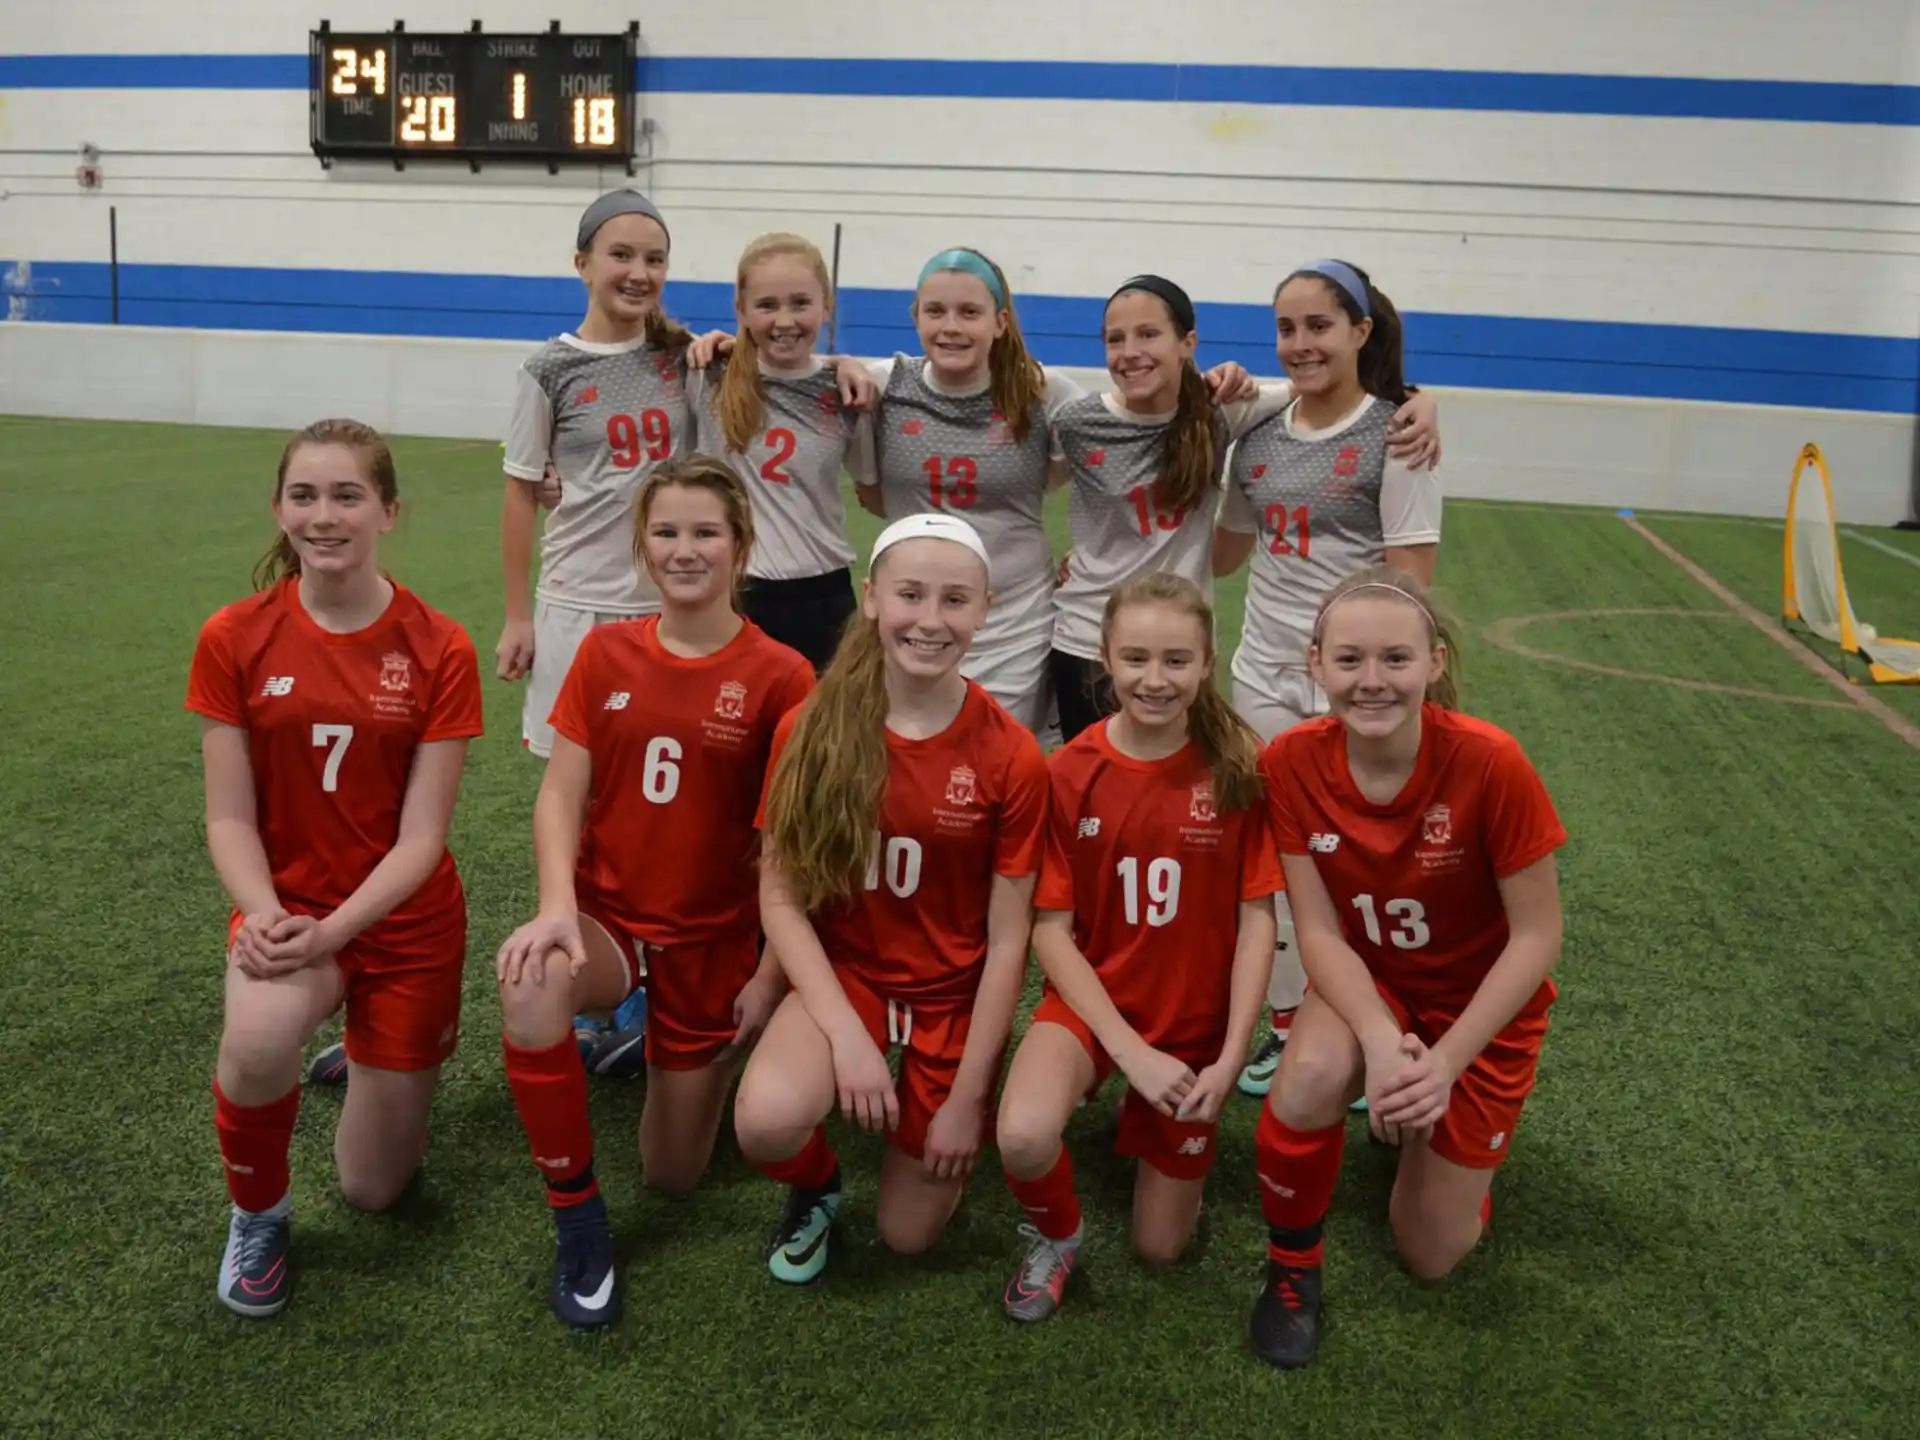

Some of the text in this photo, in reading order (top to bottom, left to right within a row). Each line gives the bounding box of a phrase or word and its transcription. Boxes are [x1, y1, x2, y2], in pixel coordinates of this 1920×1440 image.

[332, 49, 386, 94] 24
[488, 40, 537, 57] STRIKE
[573, 40, 601, 58] OUT
[341, 97, 374, 116] TIME
[399, 72, 455, 95] GUEST
[513, 73, 526, 119] 1
[560, 74, 613, 98] HOME
[401, 96, 455, 141] 20
[488, 122, 538, 141] INNING
[574, 98, 615, 144] 18
[606, 408, 672, 468] 99
[760, 428, 796, 484] 2
[921, 455, 978, 509] 13
[1264, 503, 1310, 559] 21
[312, 724, 354, 792] 7
[642, 736, 683, 804] 6
[1117, 856, 1181, 927] 19
[1351, 893, 1430, 949] 13
